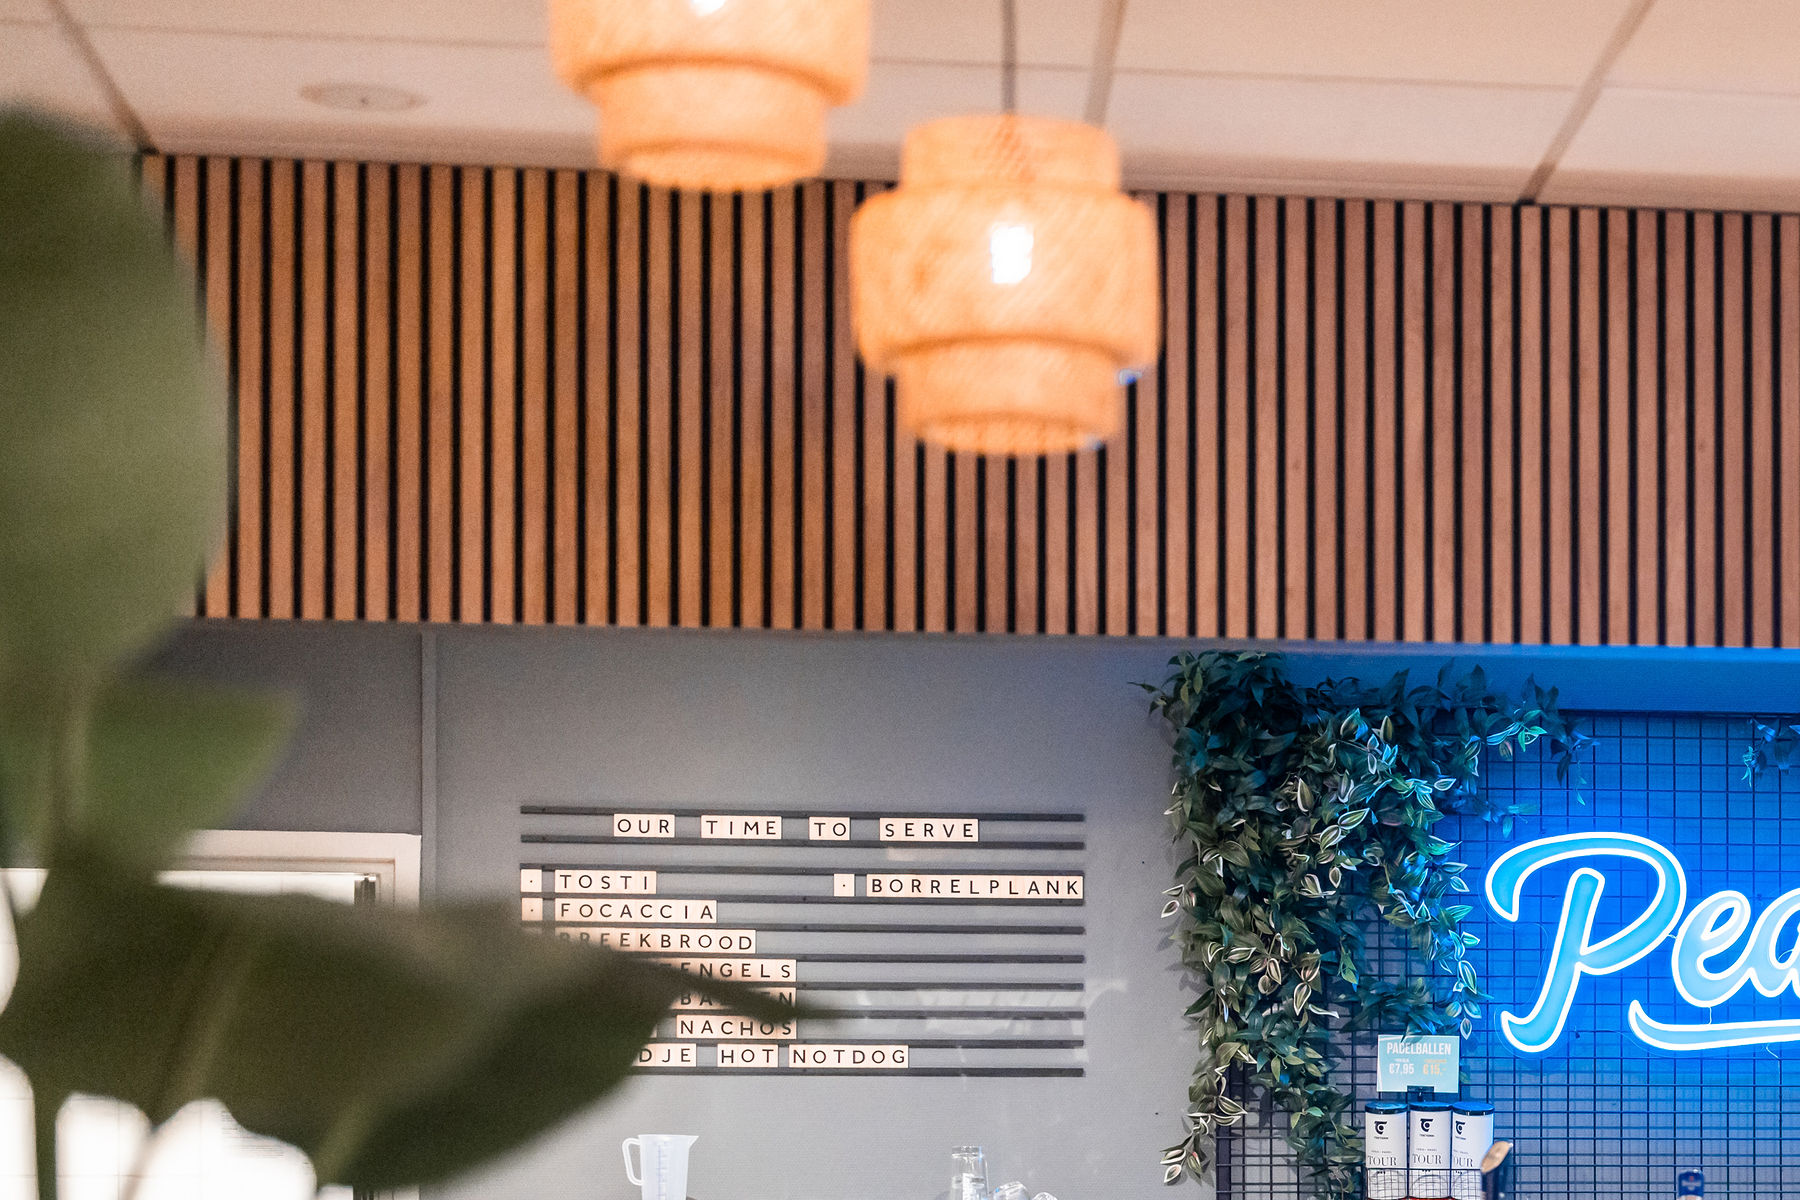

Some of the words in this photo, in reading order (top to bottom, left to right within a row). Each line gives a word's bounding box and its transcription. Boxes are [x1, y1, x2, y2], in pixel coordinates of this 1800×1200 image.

[617, 818, 670, 834] OUR
[705, 820, 776, 836] TIME
[813, 822, 847, 838] TO
[885, 823, 974, 839] SERVE
[558, 873, 649, 890] TOSTI
[871, 878, 1079, 896] BORRELPLANK
[560, 903, 714, 921] FOCACCIA
[680, 1019, 793, 1036] NACHOS
[721, 1049, 774, 1065] HOT
[793, 1049, 906, 1066] NOTDOG
[1368, 1155, 1397, 1167] TOUR
[1412, 1153, 1442, 1165] TOUR
